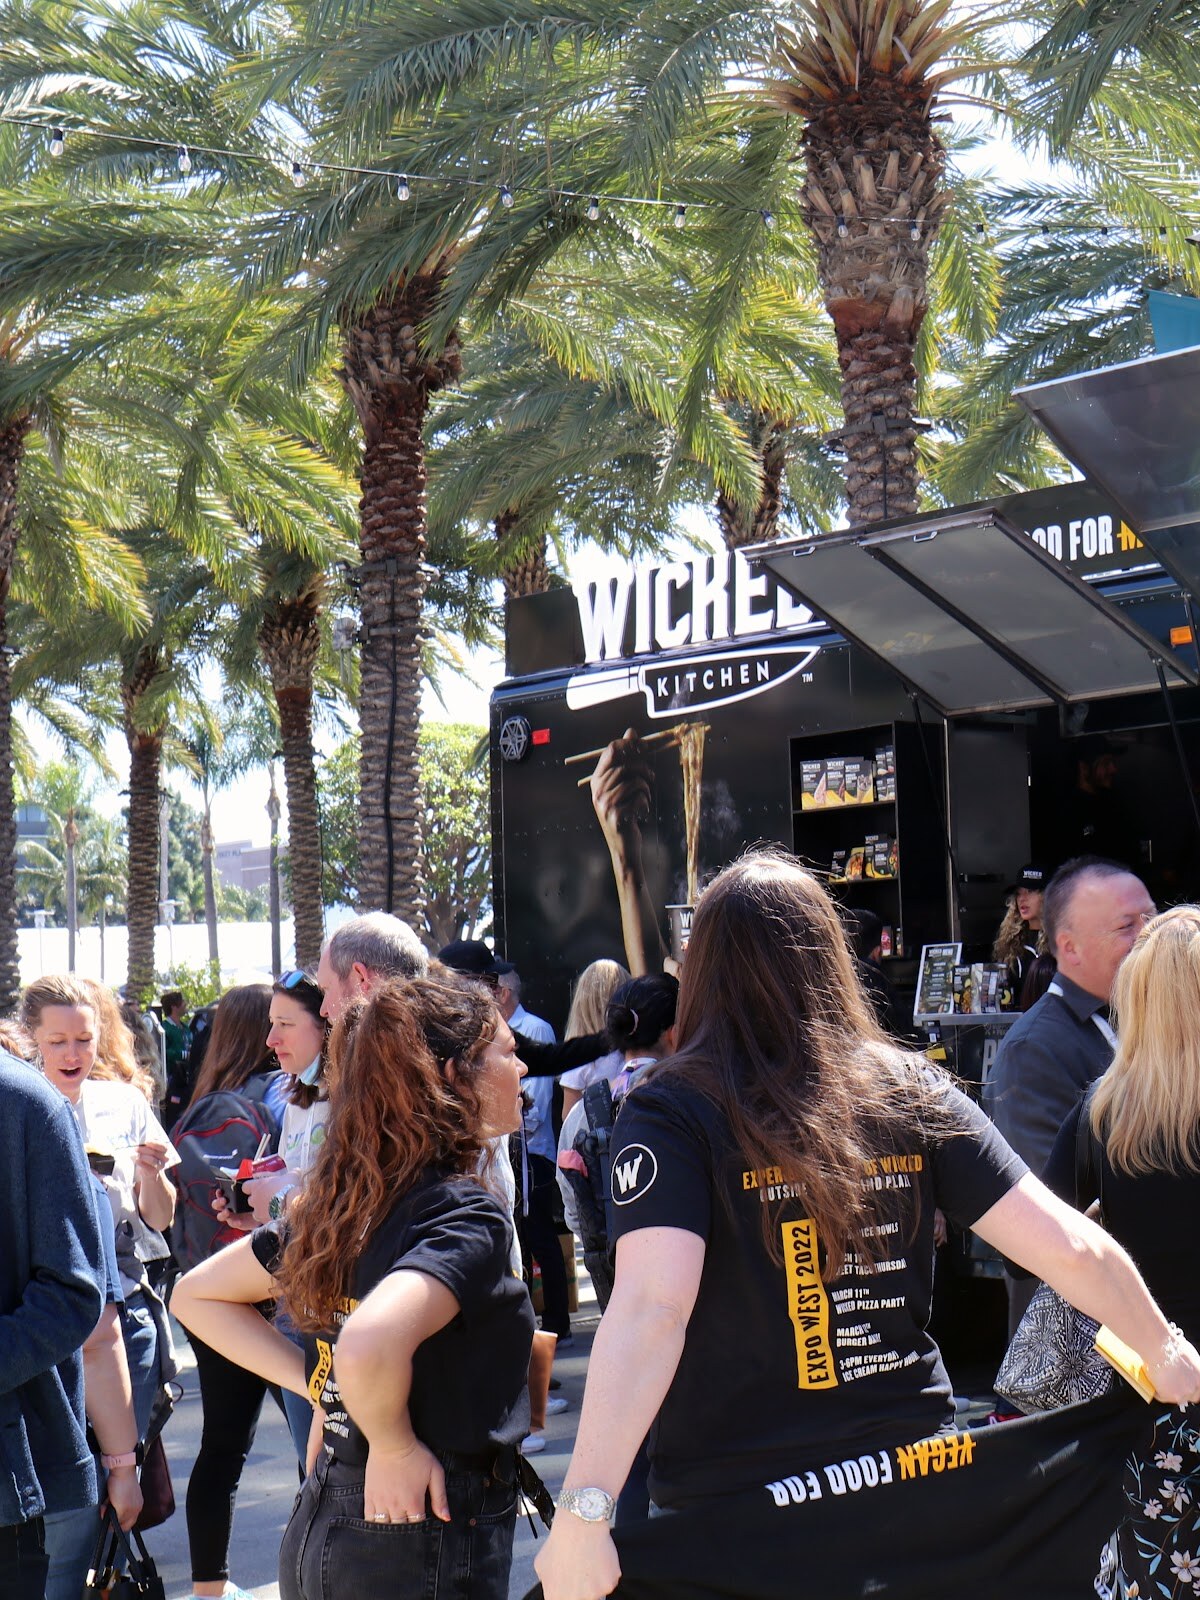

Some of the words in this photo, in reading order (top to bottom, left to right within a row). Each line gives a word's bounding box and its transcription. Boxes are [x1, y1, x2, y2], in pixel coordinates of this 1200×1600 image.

[1069, 515, 1113, 561] FOR
[657, 660, 770, 698] KITCHEN
[792, 1225, 815, 1277] 2022
[798, 1283, 821, 1332] WEST
[831, 1288, 853, 1302] MARCH
[857, 1300, 880, 1310] PIZZA
[880, 1296, 906, 1309] PARTY
[804, 1335, 830, 1384] EXPO
[836, 1336, 868, 1348] BURGER
[840, 1355, 863, 1371] 3-6PM
[314, 1346, 329, 1391] 2022
[842, 1370, 855, 1383] ICE
[853, 1363, 878, 1379] CREAM
[879, 1359, 904, 1373] HAPPY
[823, 1450, 893, 1496] FOOD
[896, 1432, 976, 1480] VEGAN
